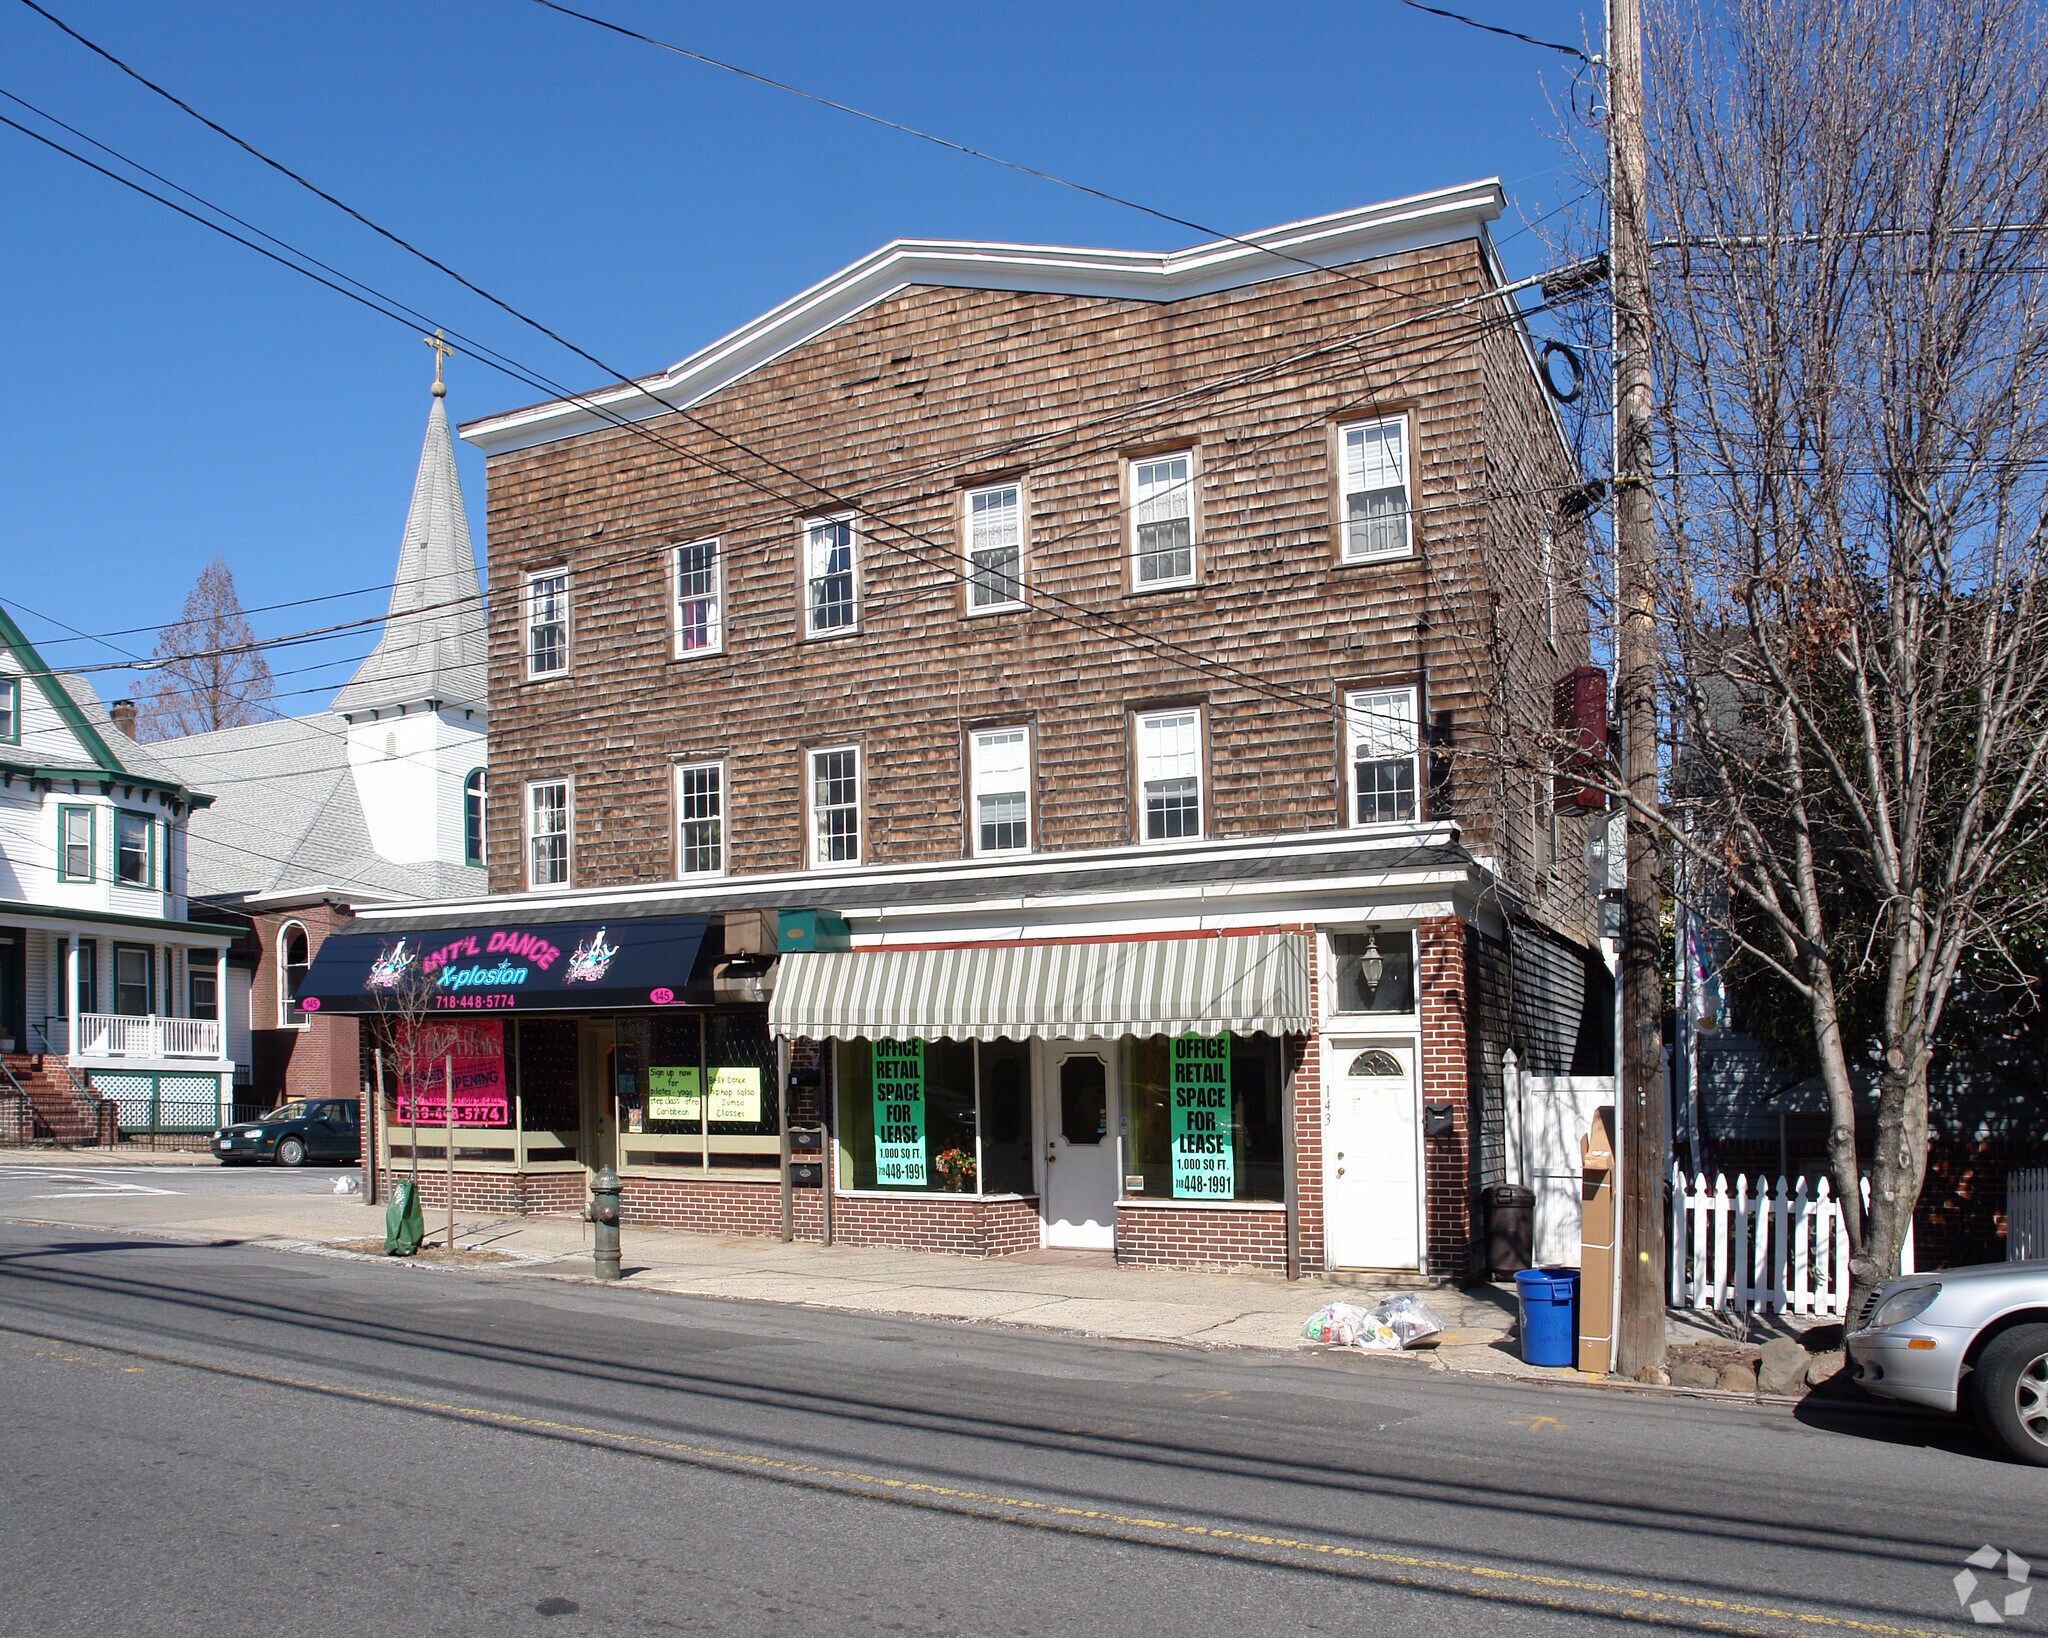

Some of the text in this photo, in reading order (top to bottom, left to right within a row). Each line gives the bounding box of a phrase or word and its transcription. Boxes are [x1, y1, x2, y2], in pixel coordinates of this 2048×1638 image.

[487, 931, 561, 971] DANCE
[437, 958, 528, 991] X-plosion
[655, 990, 670, 1001] 145
[877, 1038, 920, 1057] OFFICE
[650, 1068, 665, 1078] Sign
[666, 1070, 675, 1080] up
[876, 1060, 920, 1079] RETAIL
[1175, 1063, 1226, 1083] RETAIL
[668, 1078, 679, 1086] for
[677, 1090, 693, 1098] yoga
[877, 1083, 920, 1101] SPACE
[1176, 1087, 1225, 1108] SPACE
[650, 1098, 663, 1106] step
[886, 1104, 911, 1122] FOR
[1187, 1111, 1216, 1131] FOR
[880, 1125, 918, 1143] LEASE
[1180, 1134, 1224, 1154] LEASE
[901, 1148, 911, 1160] SQ
[1177, 1158, 1201, 1170] 1,000
[1203, 1158, 1214, 1171] SQ
